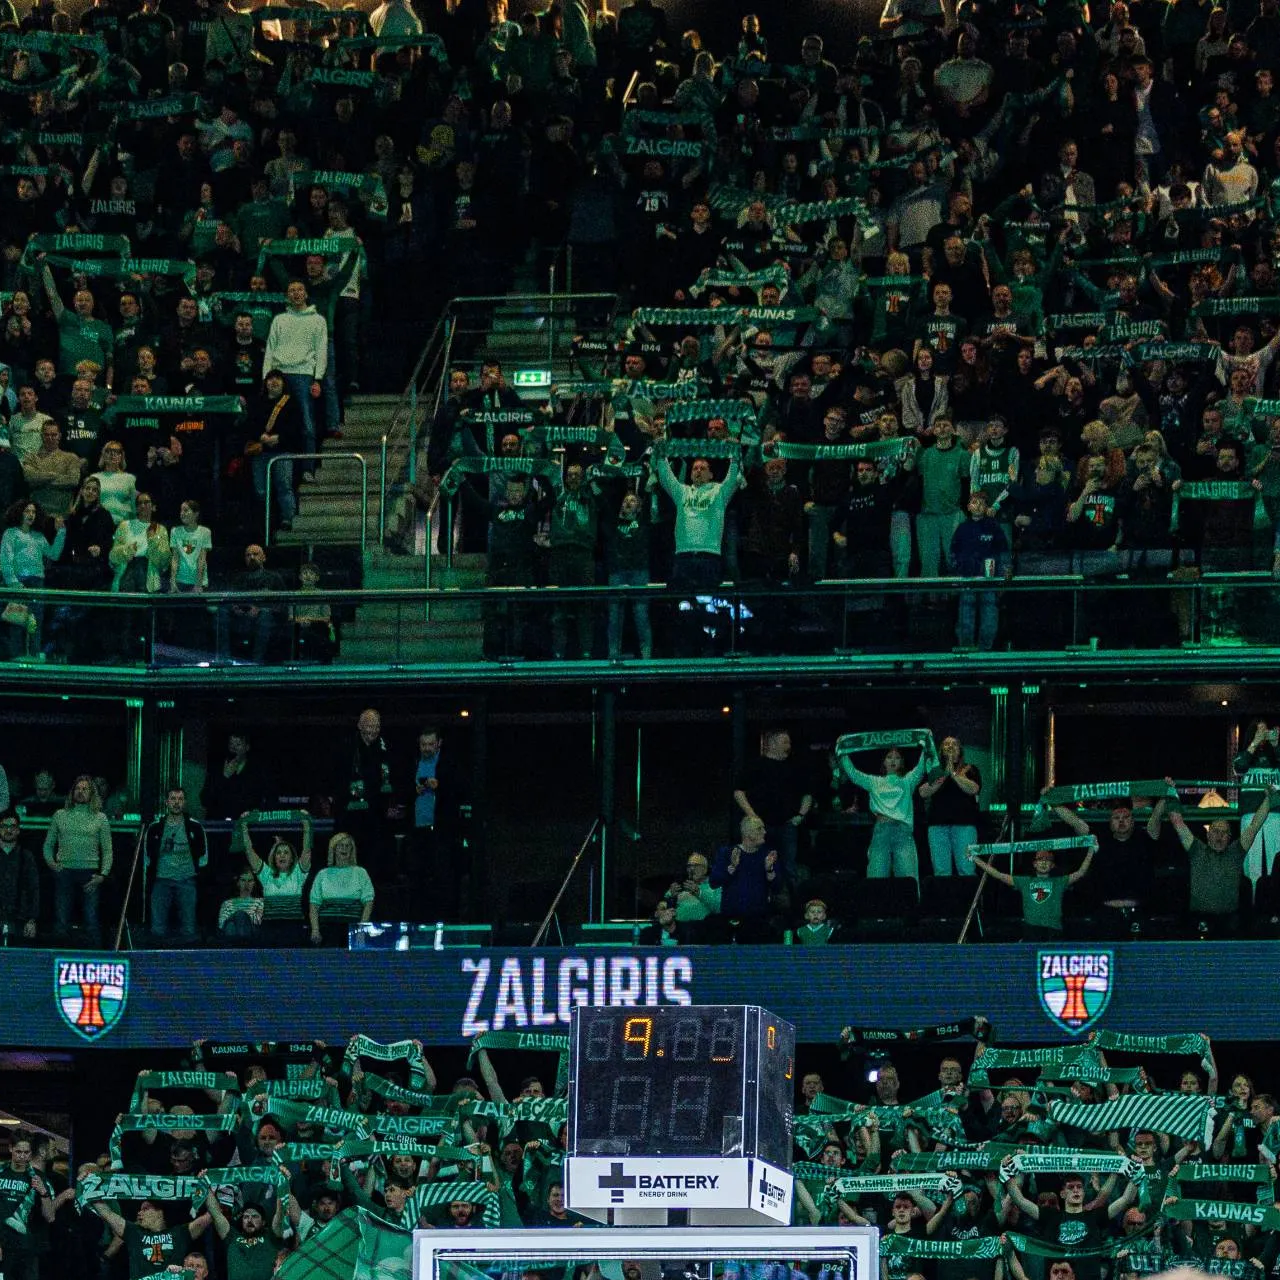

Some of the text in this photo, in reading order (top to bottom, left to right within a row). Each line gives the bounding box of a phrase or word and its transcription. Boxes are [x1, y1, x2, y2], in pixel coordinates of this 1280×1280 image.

[145, 396, 204, 410] KAUNAS
[863, 1025, 960, 1041] KAUNAS 1944
[212, 1043, 313, 1055] KAUNAS 1944
[1195, 1201, 1267, 1223] KAUNAS
